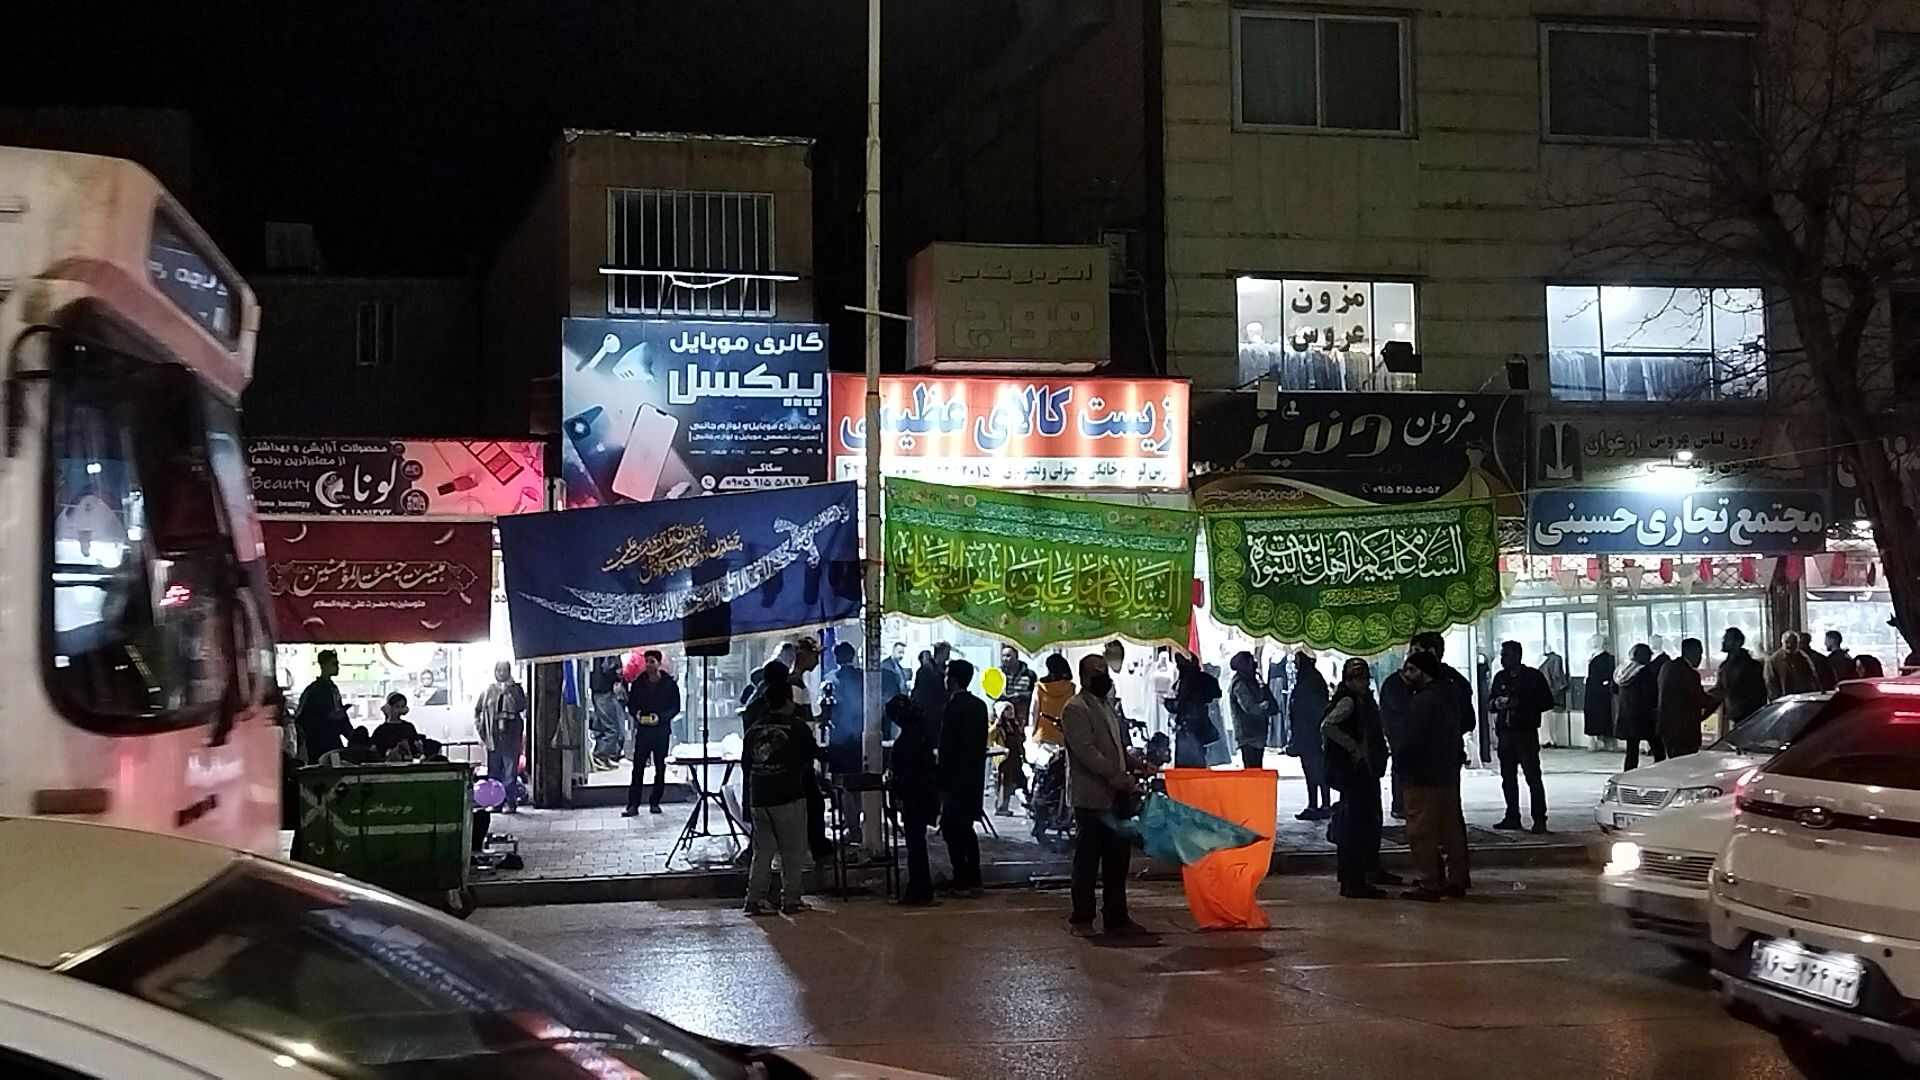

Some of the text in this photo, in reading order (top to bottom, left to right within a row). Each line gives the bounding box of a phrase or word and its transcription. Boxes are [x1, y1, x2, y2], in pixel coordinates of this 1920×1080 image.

[1291, 284, 1365, 313] مزون
[669, 331, 824, 355] گالری موبایل
[1290, 325, 1365, 352] عروس
[668, 363, 823, 416] پیکسل
[975, 384, 1073, 452] کالای
[1079, 396, 1174, 453] زیست
[1403, 398, 1476, 447] مزون
[248, 441, 291, 453] بهداشتی
[340, 442, 388, 454] محصولات
[1584, 430, 1642, 457] ارغوان
[252, 476, 310, 492] Beauty
[353, 458, 397, 505] لونا
[1534, 495, 1823, 546] مجتمع تجاری حسینی
